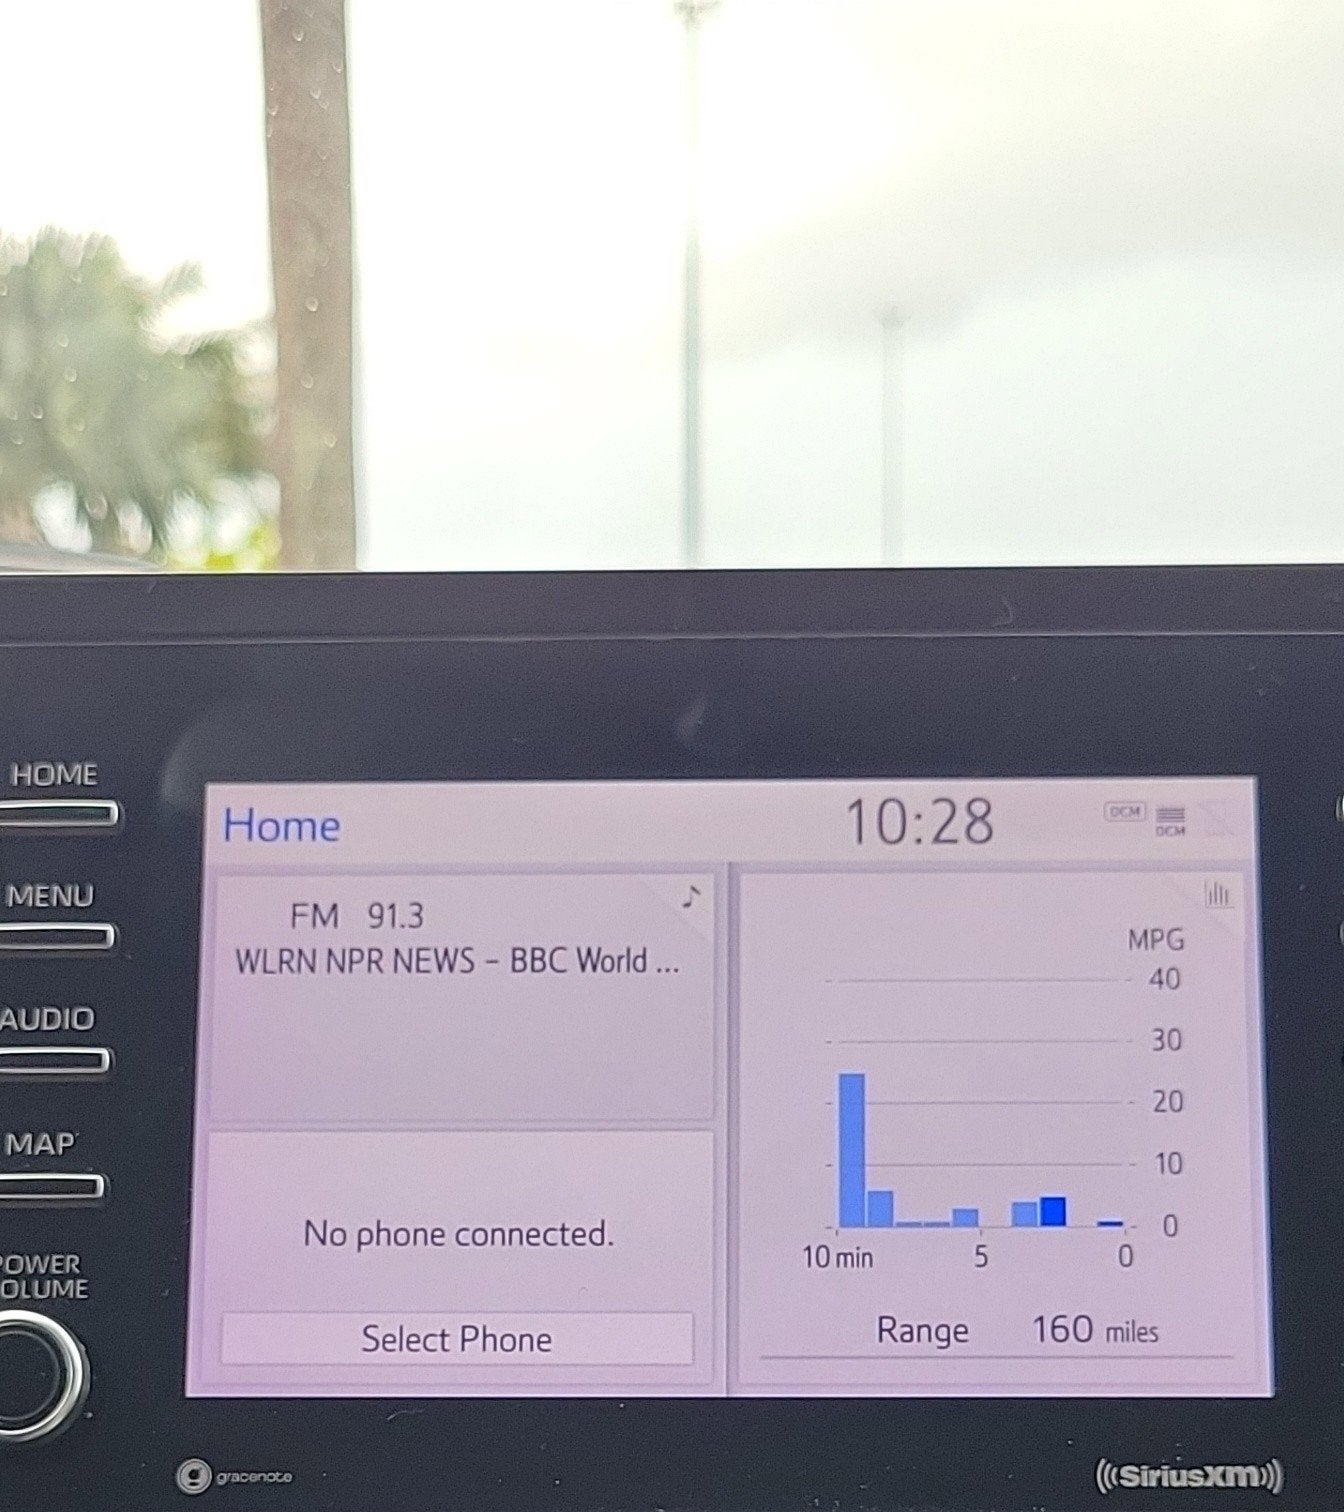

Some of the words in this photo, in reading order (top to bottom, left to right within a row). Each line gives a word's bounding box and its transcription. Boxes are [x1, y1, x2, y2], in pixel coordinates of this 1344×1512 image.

[11, 763, 97, 786] HOME
[225, 807, 340, 842] Home
[849, 797, 993, 845] 10:28
[6, 884, 93, 907] MENU
[291, 902, 338, 928] FM
[368, 901, 423, 929] 91.3
[1129, 927, 1185, 951] MPG
[236, 948, 316, 974] WLRN
[327, 947, 383, 973] NPR
[394, 947, 475, 974] NEWS
[511, 946, 567, 973] BBC
[576, 947, 647, 973] World
[1149, 966, 1181, 990] 40
[1153, 1027, 1183, 1051] 30
[1154, 1089, 1184, 1113] 20
[6, 1133, 73, 1155] MAP
[1156, 1151, 1183, 1175] 10
[305, 1219, 347, 1246] No
[357, 1219, 445, 1252] phone
[455, 1219, 613, 1246] connected.
[1163, 1213, 1178, 1237] 0
[804, 1244, 830, 1268] 10
[836, 1246, 873, 1268] min
[975, 1244, 988, 1268] 5
[1119, 1244, 1134, 1268] 0
[362, 1324, 450, 1352] Select
[461, 1325, 552, 1352] Phone
[879, 1315, 968, 1350] Range
[1034, 1315, 1093, 1343] 160
[1106, 1319, 1159, 1343] miles
